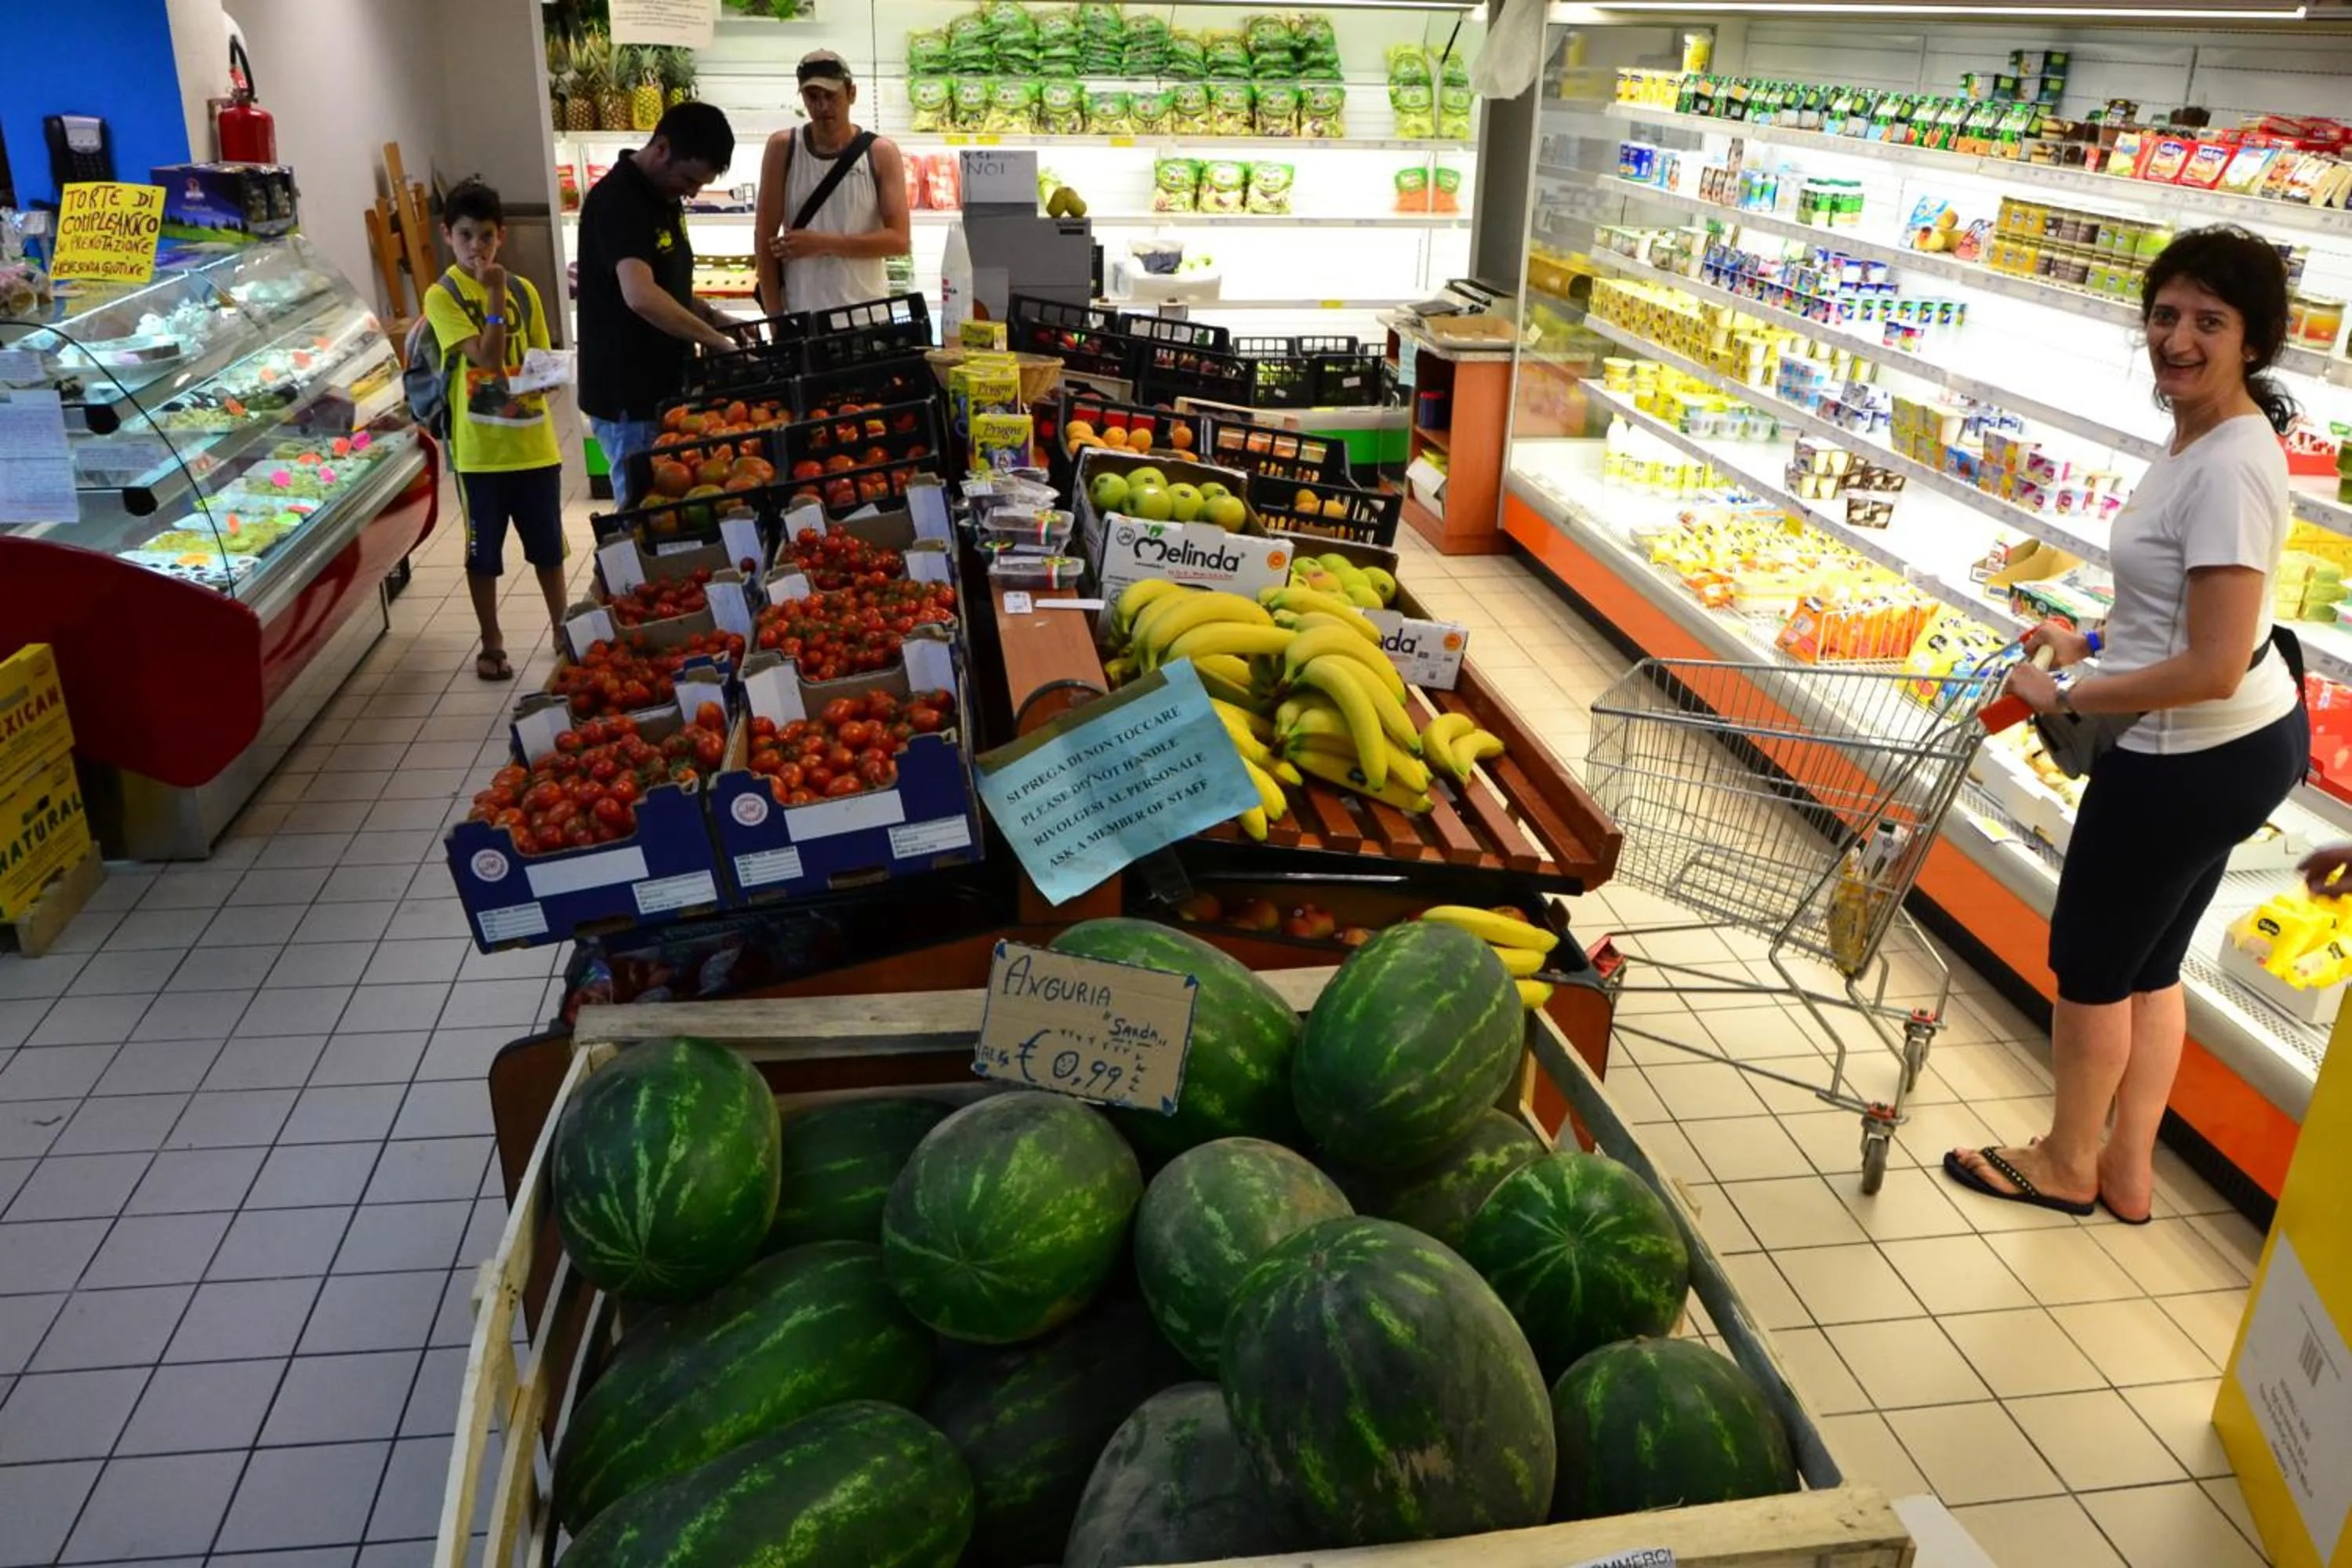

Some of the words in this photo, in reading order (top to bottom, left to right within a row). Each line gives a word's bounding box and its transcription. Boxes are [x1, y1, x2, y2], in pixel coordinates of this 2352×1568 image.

[65, 185, 124, 212] TORTE
[70, 235, 154, 255] PRENOTAZIONE
[985, 422, 1024, 440] Prugne
[1134, 536, 1240, 572] Melinda
[1006, 789, 1022, 805] SI
[1021, 764, 1067, 795] PREGA
[1066, 752, 1084, 768] DI
[1083, 739, 1114, 760] NON
[1114, 704, 1181, 744] TOCCARE
[1108, 792, 1127, 805] AL
[1125, 751, 1207, 798] PERSONALE
[1020, 789, 1071, 827] PLEASE
[1091, 764, 1120, 782] NOT
[1121, 737, 1179, 772] HANDLE
[1048, 848, 1075, 869] ASK
[1076, 840, 1088, 851] A
[1086, 809, 1146, 844] MEMBER
[1146, 800, 1164, 815] OF
[1166, 778, 1209, 806] STAFF
[1002, 954, 1112, 1007] ANGURIA
